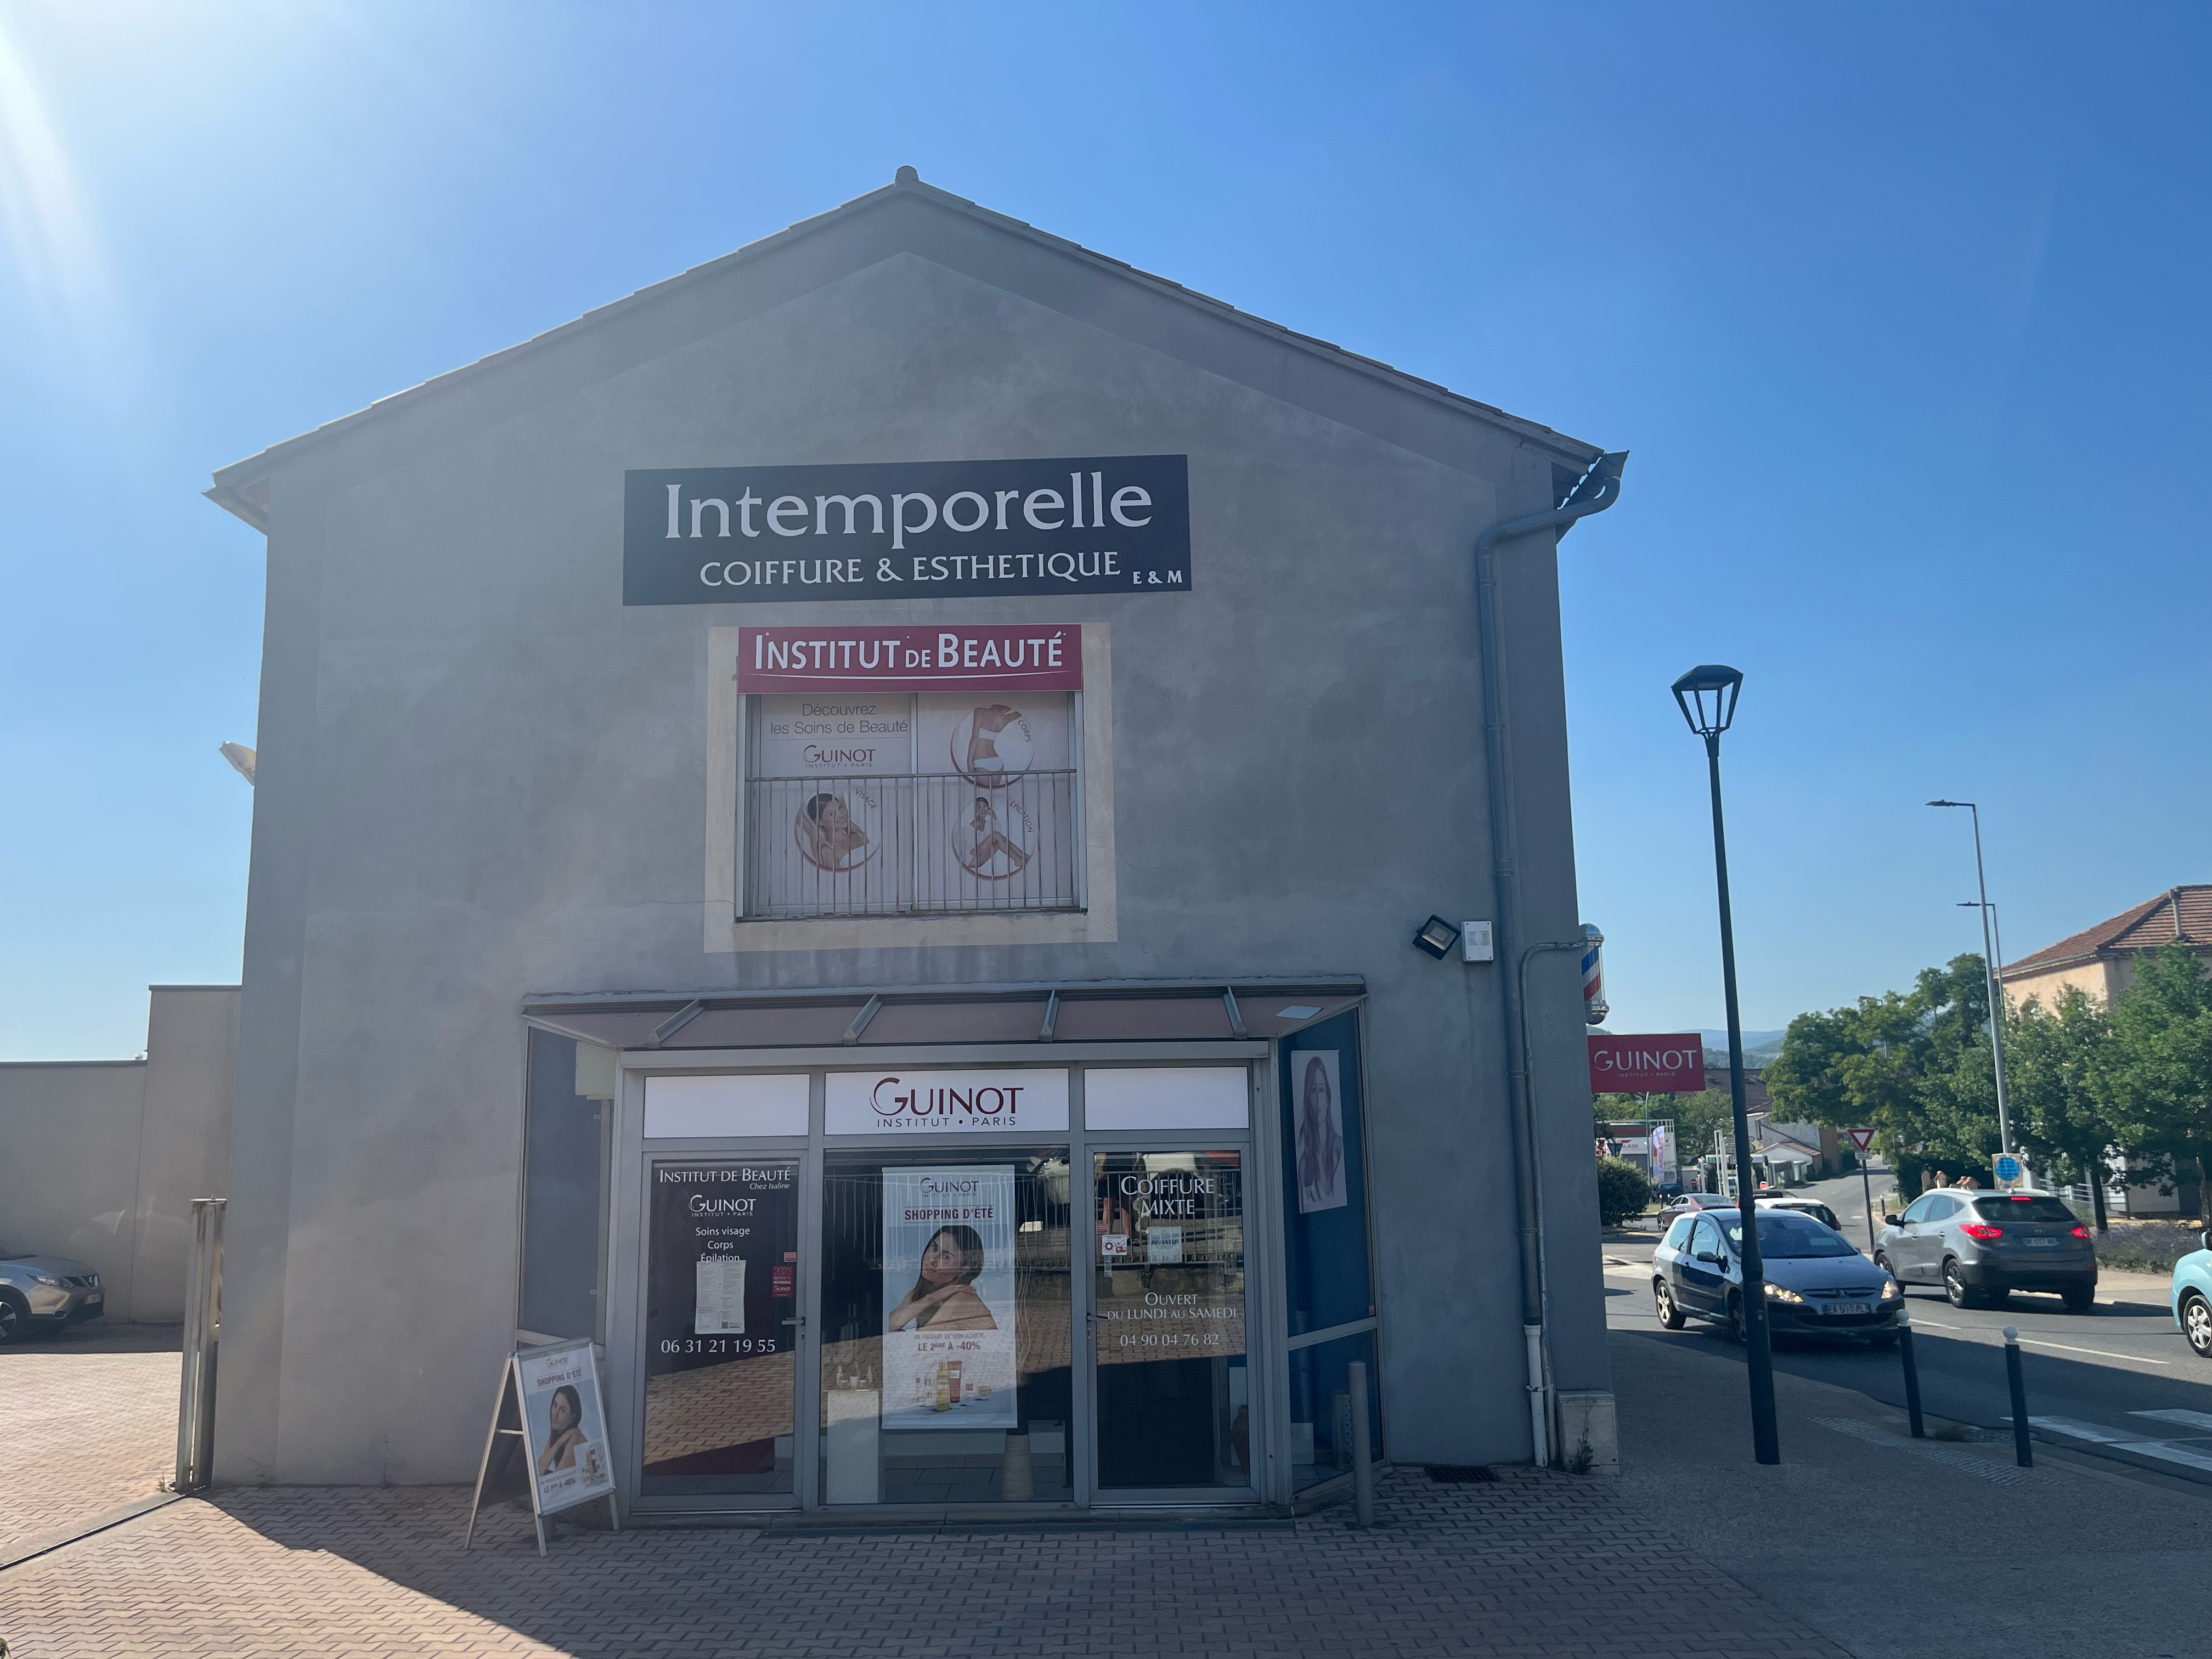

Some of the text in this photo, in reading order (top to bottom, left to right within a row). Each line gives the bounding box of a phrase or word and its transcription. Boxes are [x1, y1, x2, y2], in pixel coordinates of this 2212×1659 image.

[665, 472, 1153, 549] Intemporelle
[700, 551, 1121, 587] COIFFURE & ESTHETIQUE
[755, 630, 1063, 670] INSTITUT DE BEAUTÉ
[803, 703, 876, 716] Découvrez
[771, 720, 908, 734] les Soins de Beauté
[1018, 720, 1031, 742] CORPS
[802, 744, 876, 763] GUINOT
[856, 788, 877, 810] VISAGE
[1594, 1050, 1697, 1071] GUINOT
[870, 1077, 1024, 1116] GUINOT
[878, 1116, 1016, 1127] INSTITUT PARIS
[660, 1166, 791, 1183] INSTITUT DE BEAUTÉ
[919, 1177, 979, 1193] GUINOT
[1121, 1176, 1214, 1195] COIFFURE
[689, 1194, 757, 1212] GUINOT
[1141, 1199, 1195, 1215] MIXTE
[905, 1209, 959, 1220] SHOPPING
[696, 1227, 750, 1237] Soins visage
[708, 1241, 733, 1250] Corps
[701, 1252, 740, 1262] Épilation
[774, 1267, 792, 1276] 2023
[1145, 1292, 1198, 1305] OUVERT
[1108, 1307, 1236, 1319] DU LUNDI AU SAMEDI
[661, 1339, 775, 1353] 06 31 21 19 55
[947, 1341, 953, 1350] À
[956, 1340, 981, 1350] -40%
[1120, 1333, 1219, 1346] 04 90 04 76 82
[537, 1374, 565, 1386] SHOPPING
